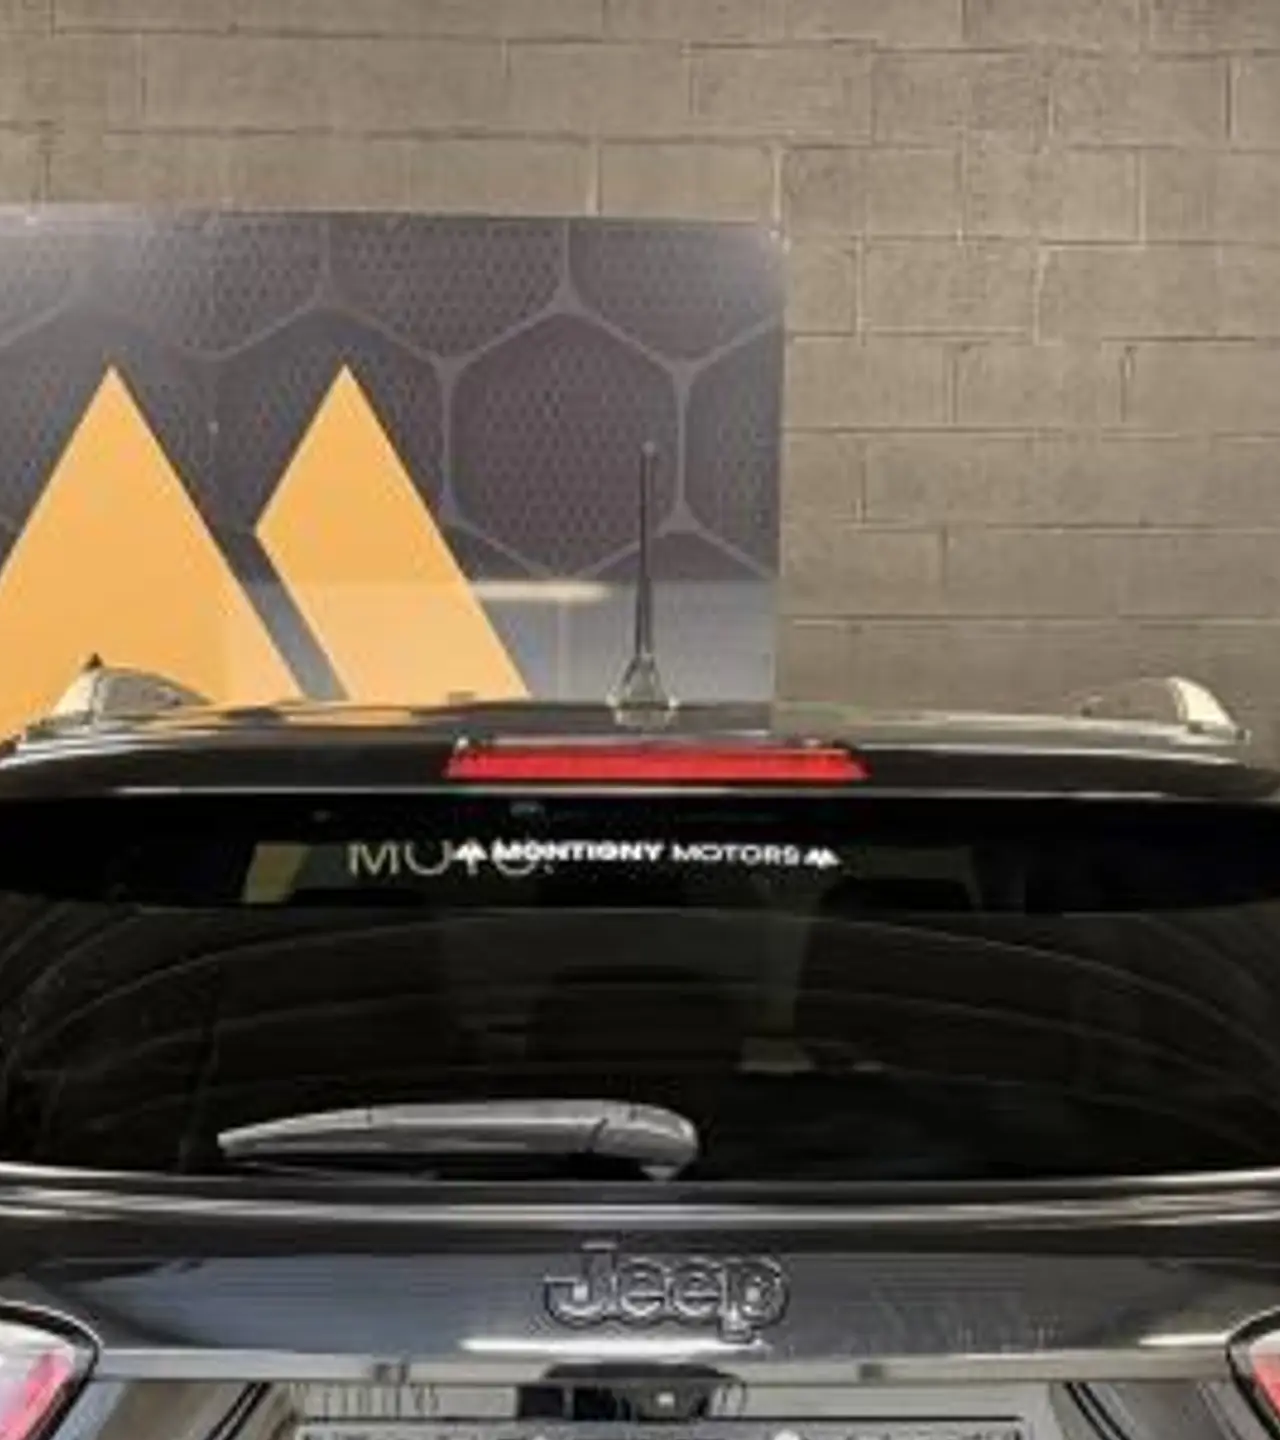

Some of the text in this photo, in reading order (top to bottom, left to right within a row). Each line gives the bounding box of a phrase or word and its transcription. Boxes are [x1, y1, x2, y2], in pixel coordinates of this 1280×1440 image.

[492, 839, 801, 867] MONTIGNY MOTORS
[542, 1242, 790, 1343] Jeep
